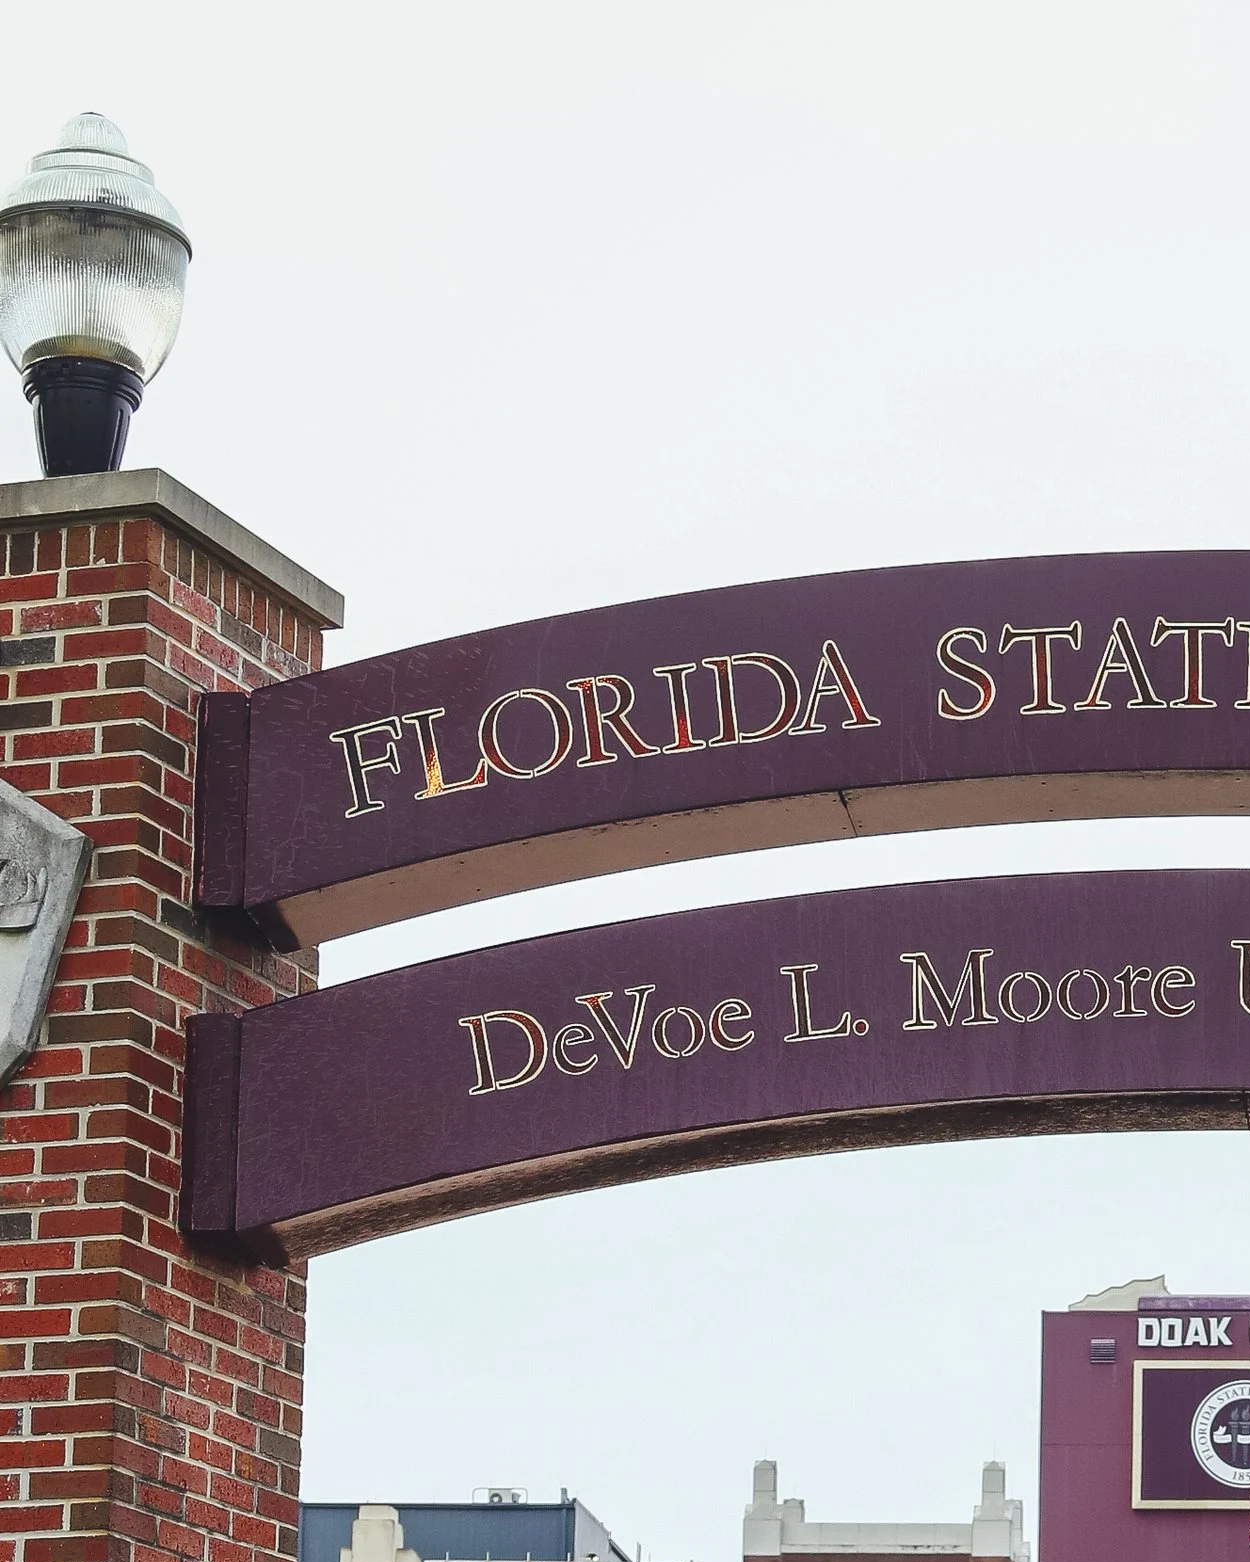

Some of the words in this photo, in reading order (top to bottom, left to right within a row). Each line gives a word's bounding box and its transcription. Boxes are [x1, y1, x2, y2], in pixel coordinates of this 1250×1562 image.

[330, 639, 881, 818] FLORIDA
[458, 983, 755, 1096] DeVoe
[779, 963, 870, 1043] L.
[899, 948, 1196, 1031] Moore
[1137, 1316, 1234, 1347] DOAK
[1198, 1404, 1217, 1461] FLORIDA
